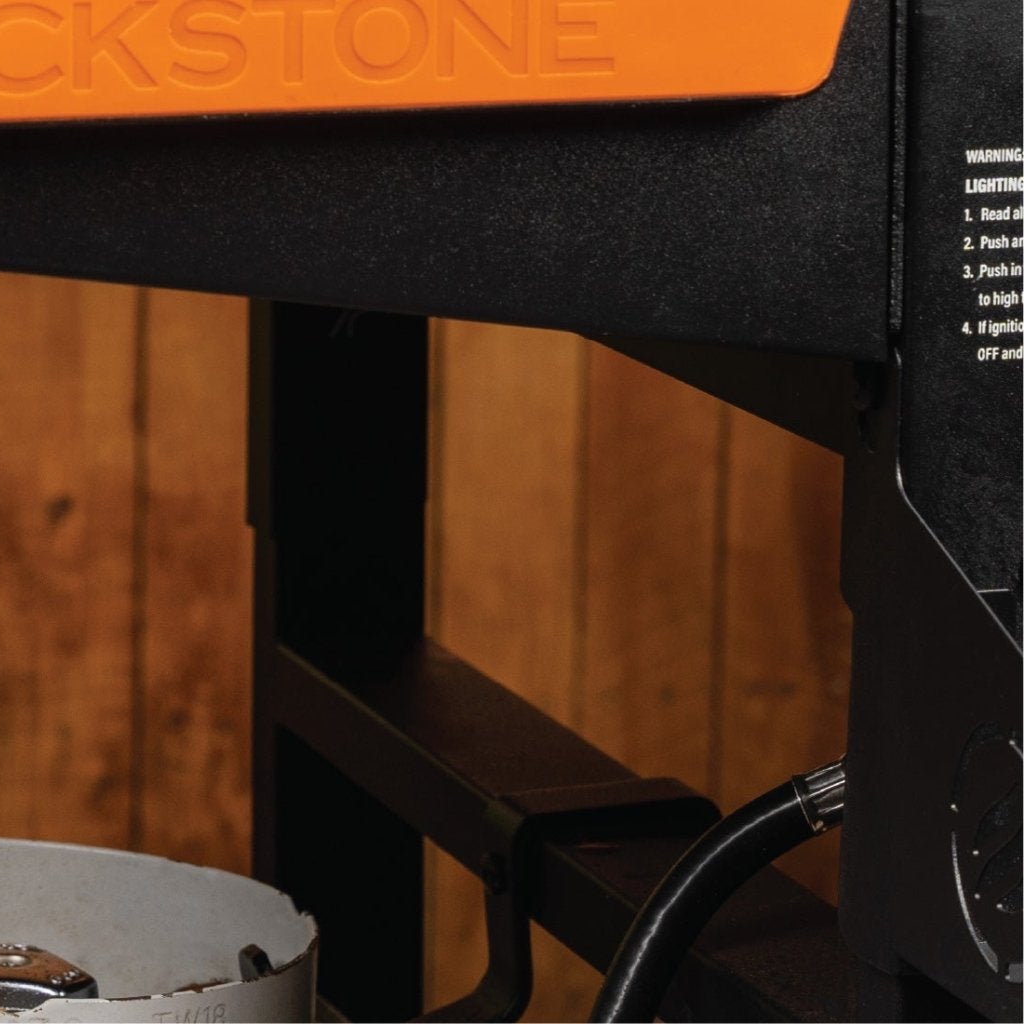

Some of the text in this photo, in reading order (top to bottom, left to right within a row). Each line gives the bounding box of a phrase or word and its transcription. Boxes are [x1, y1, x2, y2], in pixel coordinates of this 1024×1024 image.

[965, 177, 1024, 193] LIGHTING
[964, 209, 973, 221] 1.
[980, 207, 1010, 221] Read
[963, 237, 974, 250] 2.
[980, 235, 1009, 249] Push
[963, 262, 1022, 278] 3. Push in
[978, 293, 990, 306] to
[993, 291, 1019, 308] high
[962, 322, 972, 334] 4.
[978, 321, 987, 334] If
[977, 345, 1024, 361] OFF and
